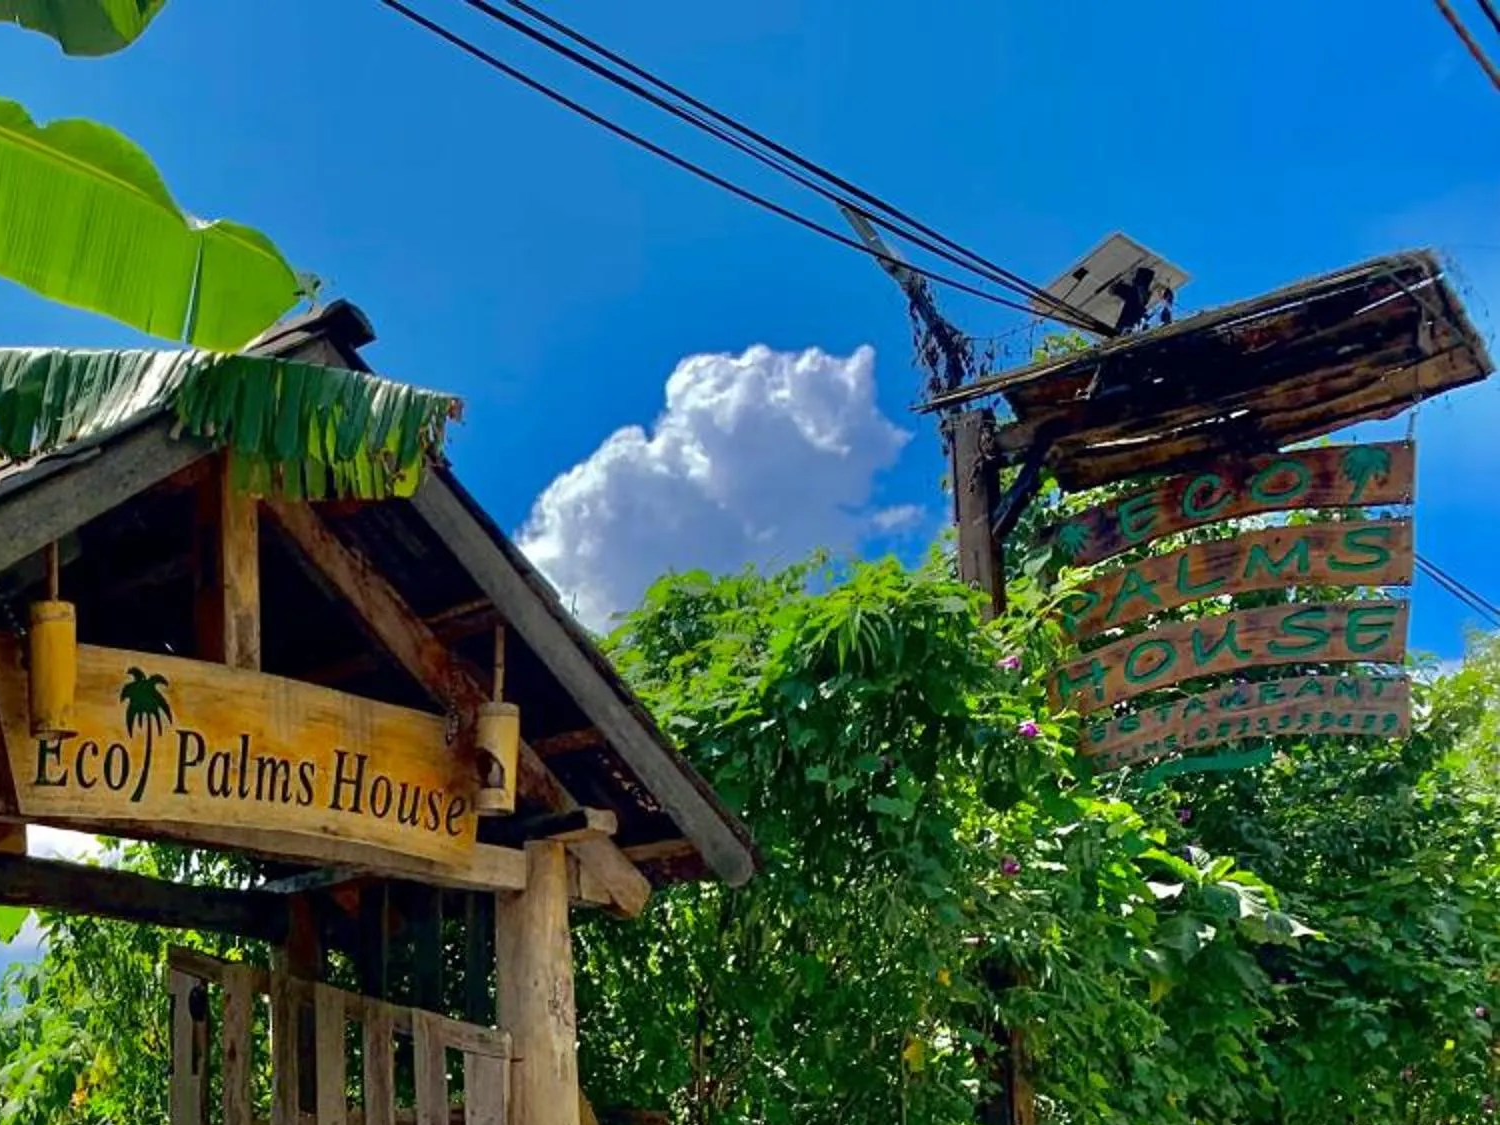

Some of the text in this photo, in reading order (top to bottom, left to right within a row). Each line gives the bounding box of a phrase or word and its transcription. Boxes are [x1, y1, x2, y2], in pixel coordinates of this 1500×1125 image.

[1116, 459, 1311, 542] ECO
[1062, 526, 1393, 635] PALMS
[1054, 606, 1398, 701] HOUSE
[33, 729, 466, 837] Eco Palms House
